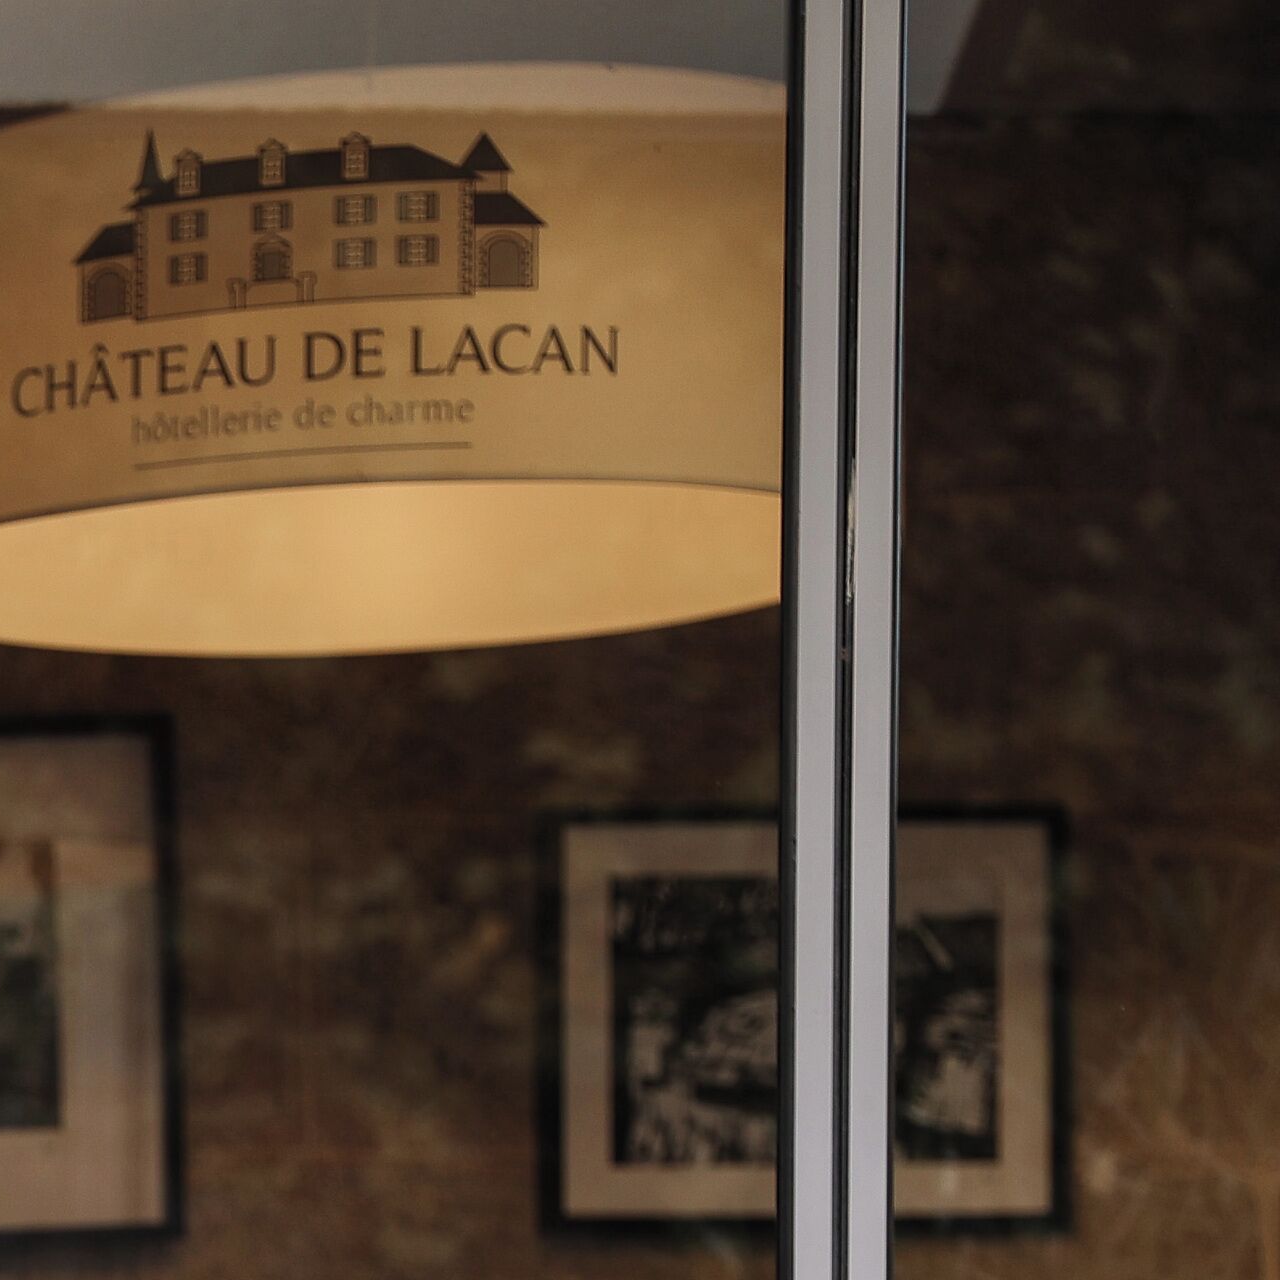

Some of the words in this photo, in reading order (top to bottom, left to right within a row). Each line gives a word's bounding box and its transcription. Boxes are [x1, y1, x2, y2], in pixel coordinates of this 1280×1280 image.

[11, 334, 278, 418] CHÂTEAU
[302, 327, 387, 383] DE
[409, 323, 621, 377] LACAN
[132, 400, 283, 446] hôtellerie
[293, 399, 336, 430] de
[346, 393, 476, 428] charme
